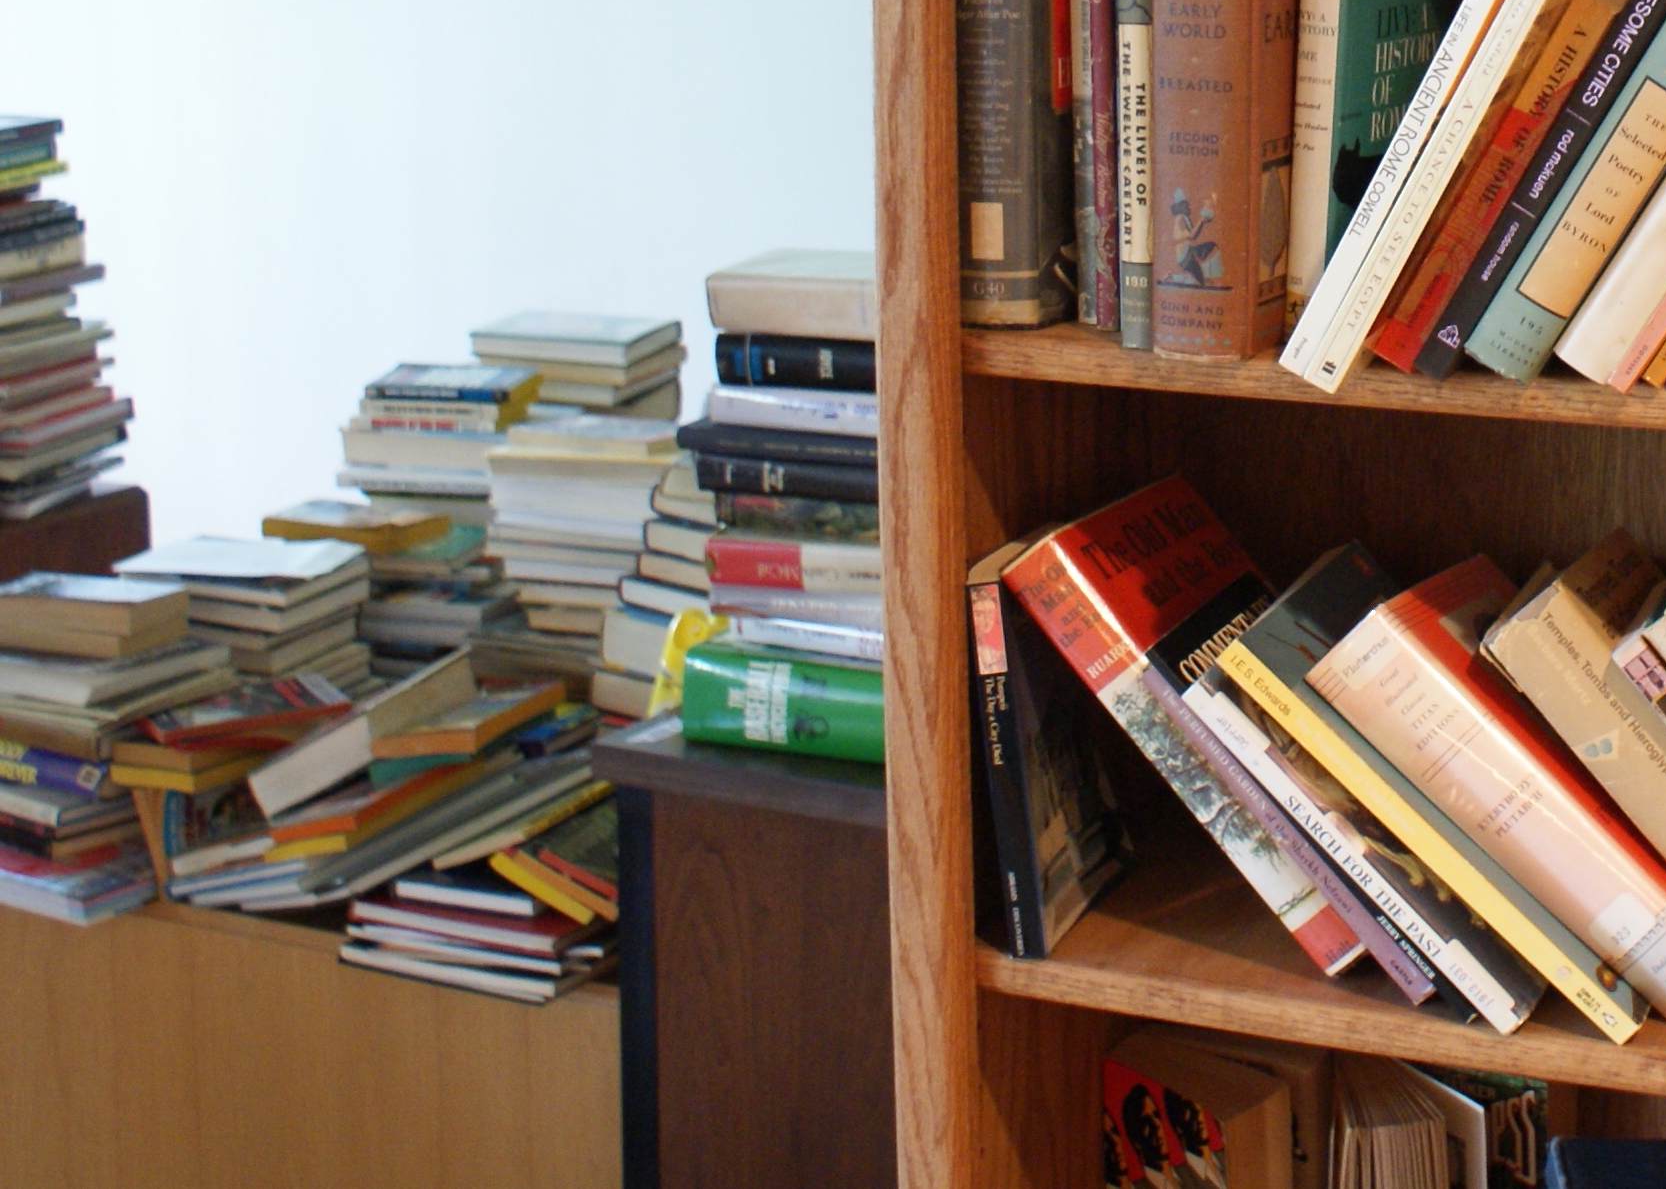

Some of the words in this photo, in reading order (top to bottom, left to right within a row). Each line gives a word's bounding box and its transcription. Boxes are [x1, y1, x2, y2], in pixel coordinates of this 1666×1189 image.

[1168, 2, 1223, 19] EARLY
[1163, 22, 1227, 40] WORLD
[1121, 41, 1132, 75] THE
[1159, 77, 1233, 93] BREASTED
[1370, 75, 1395, 108] OF
[1412, 51, 1455, 130] ANCIENT
[1581, 52, 1622, 109] CITIES
[1136, 83, 1148, 116] THE
[1122, 84, 1133, 156] TWELVE
[1136, 125, 1147, 172] LIVES
[1169, 131, 1220, 145] SECOND
[1169, 145, 1220, 159] EDITION
[1557, 127, 1576, 154] rod
[1379, 126, 1419, 185] ROME
[1606, 154, 1646, 186] Poetry
[1528, 153, 1563, 200] mckuen
[1123, 164, 1132, 246] CAESARS
[1136, 182, 1147, 207] OF
[1348, 180, 1387, 238] COWELL
[1584, 201, 1616, 227] Lord
[1497, 220, 1521, 255] random
[1561, 220, 1607, 254] BYRON
[1344, 272, 1384, 333] EGYPT
[1160, 315, 1224, 330] COMPANY
[1252, 676, 1292, 718] Edwards
[1580, 659, 1611, 700] Tombs
[1608, 697, 1630, 722] and
[1410, 701, 1441, 732] TITAN
[1414, 709, 1462, 752] EDITIONS
[1181, 704, 1233, 764] PERFUMED
[1233, 764, 1269, 810] GARDEN
[1282, 793, 1341, 855] SEARCH
[1341, 855, 1374, 890] FOR
[1374, 887, 1406, 922] THE
[1406, 920, 1443, 959] PAST
